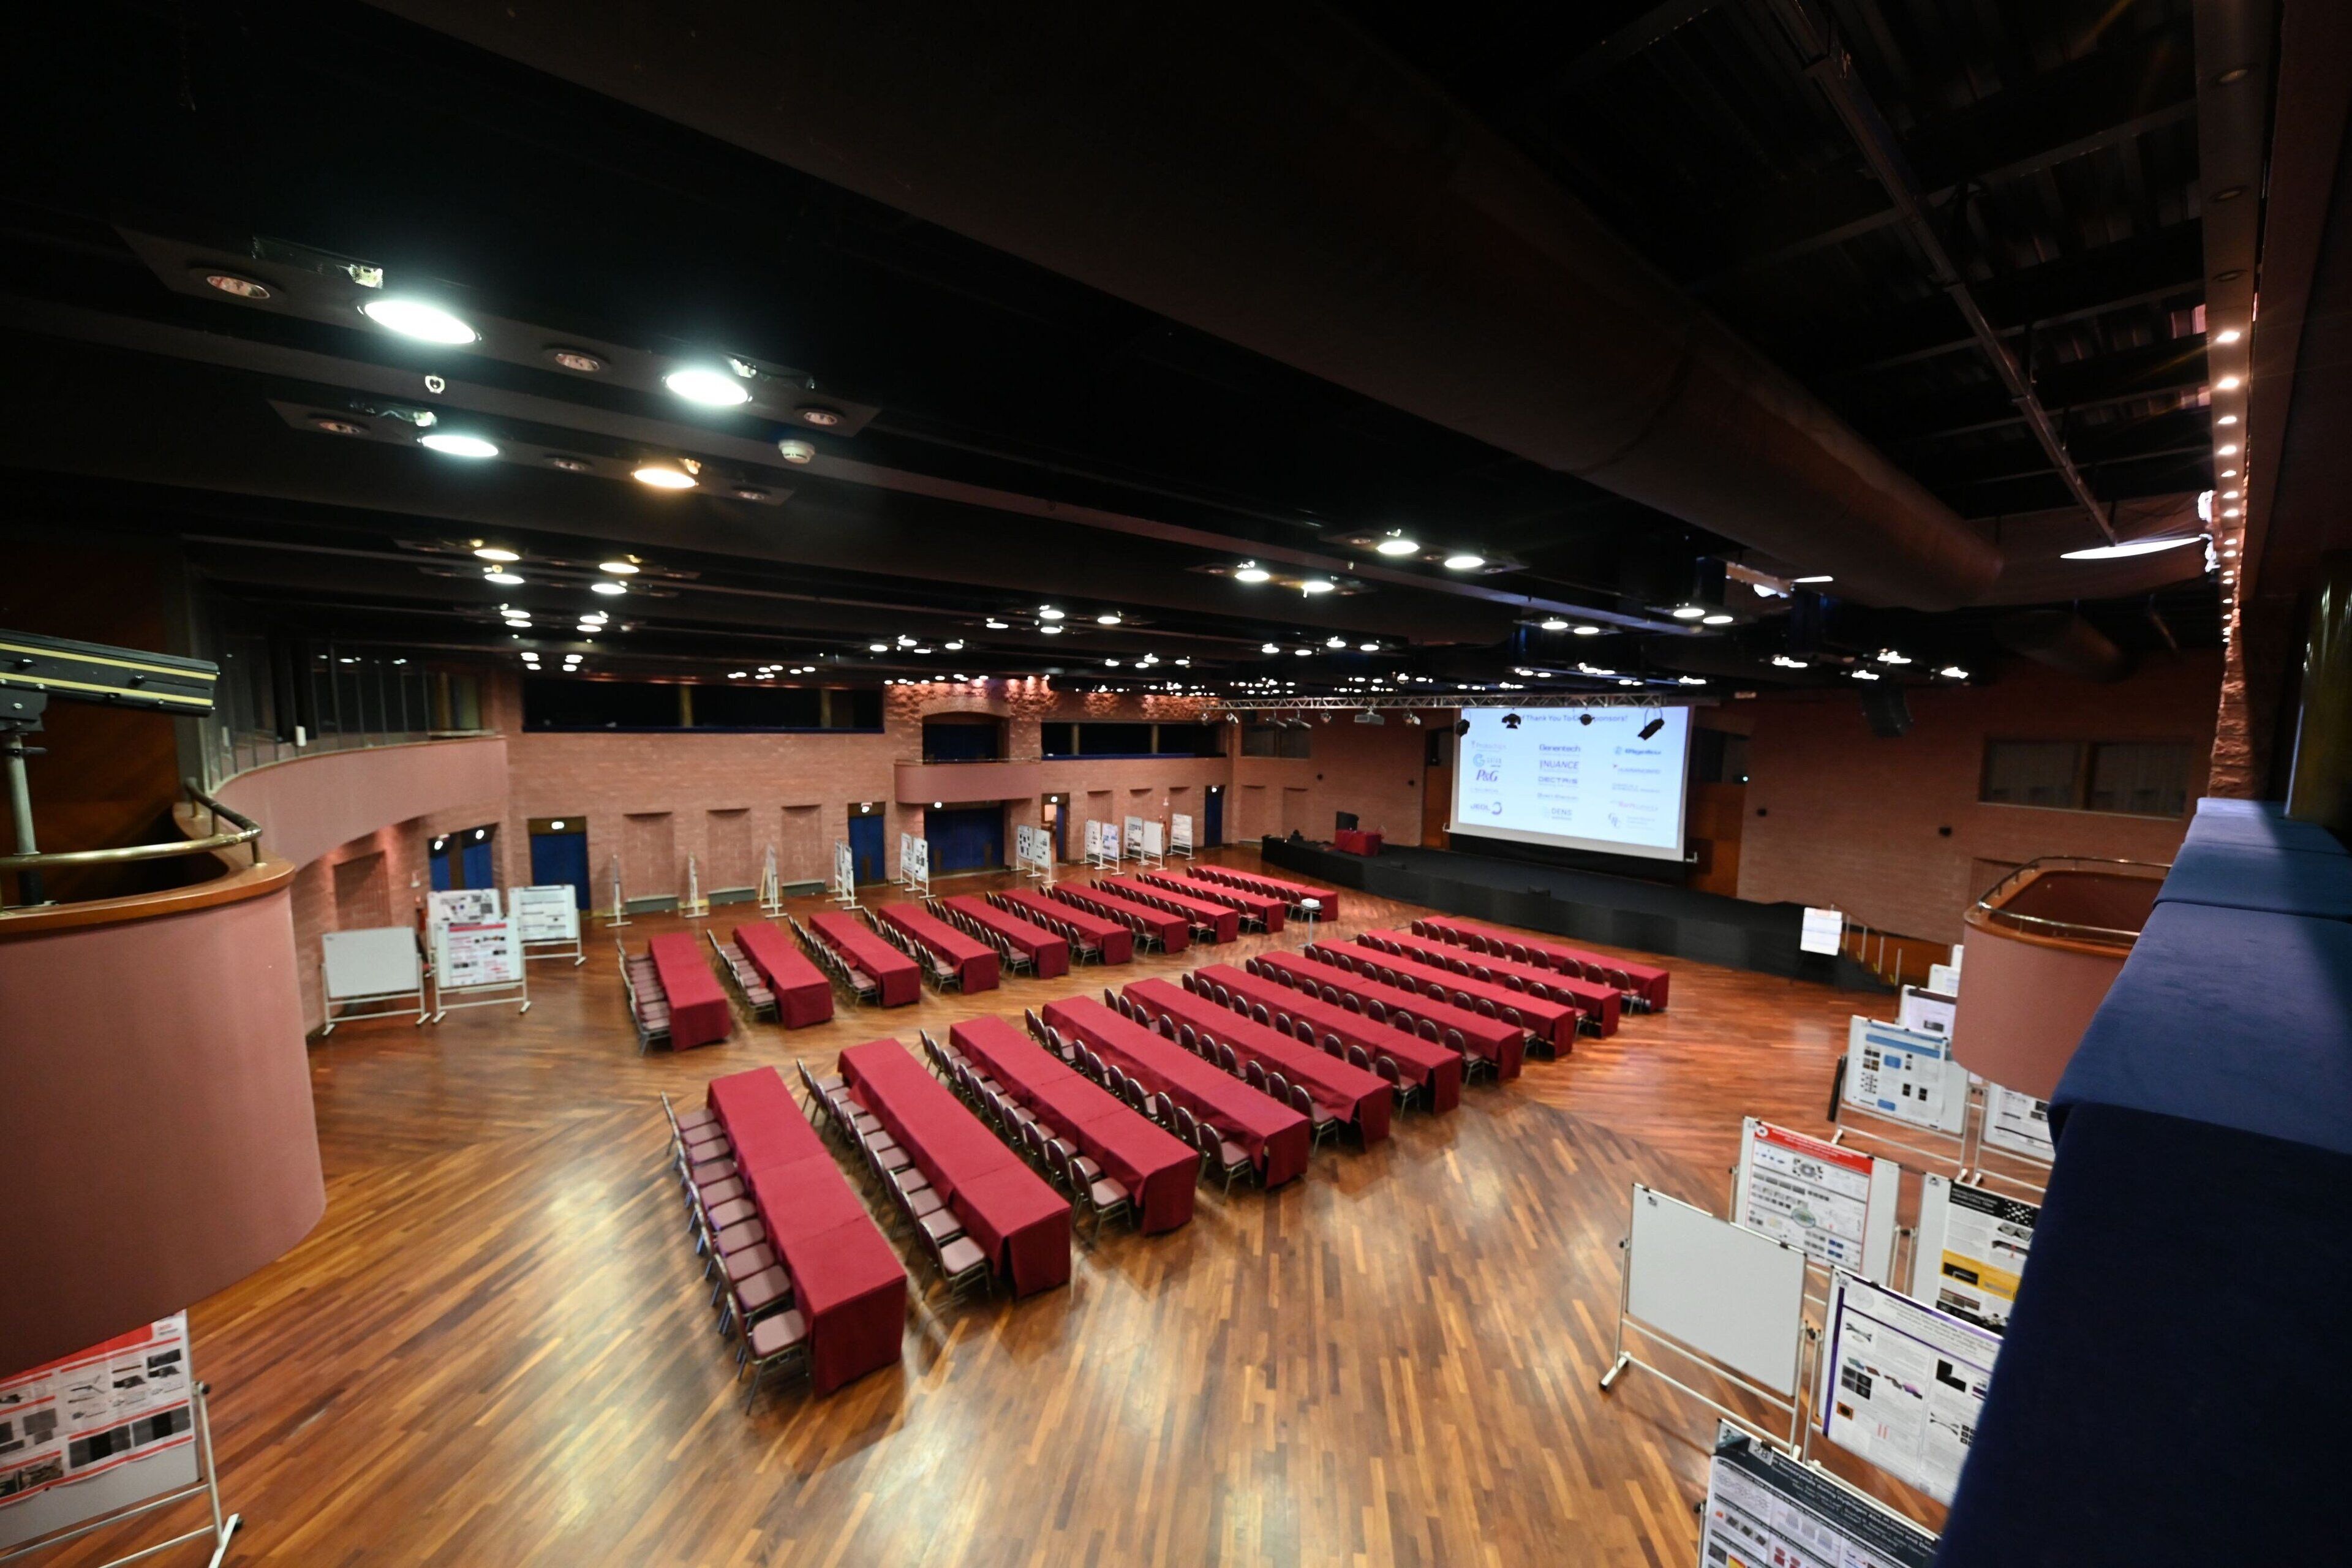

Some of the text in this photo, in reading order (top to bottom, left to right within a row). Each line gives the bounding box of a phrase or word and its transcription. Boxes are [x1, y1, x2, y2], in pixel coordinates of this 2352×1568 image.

[1539, 744, 1581, 753] Genentech
[1543, 759, 1579, 769] NUANCE
[1476, 770, 1499, 782] P&G
